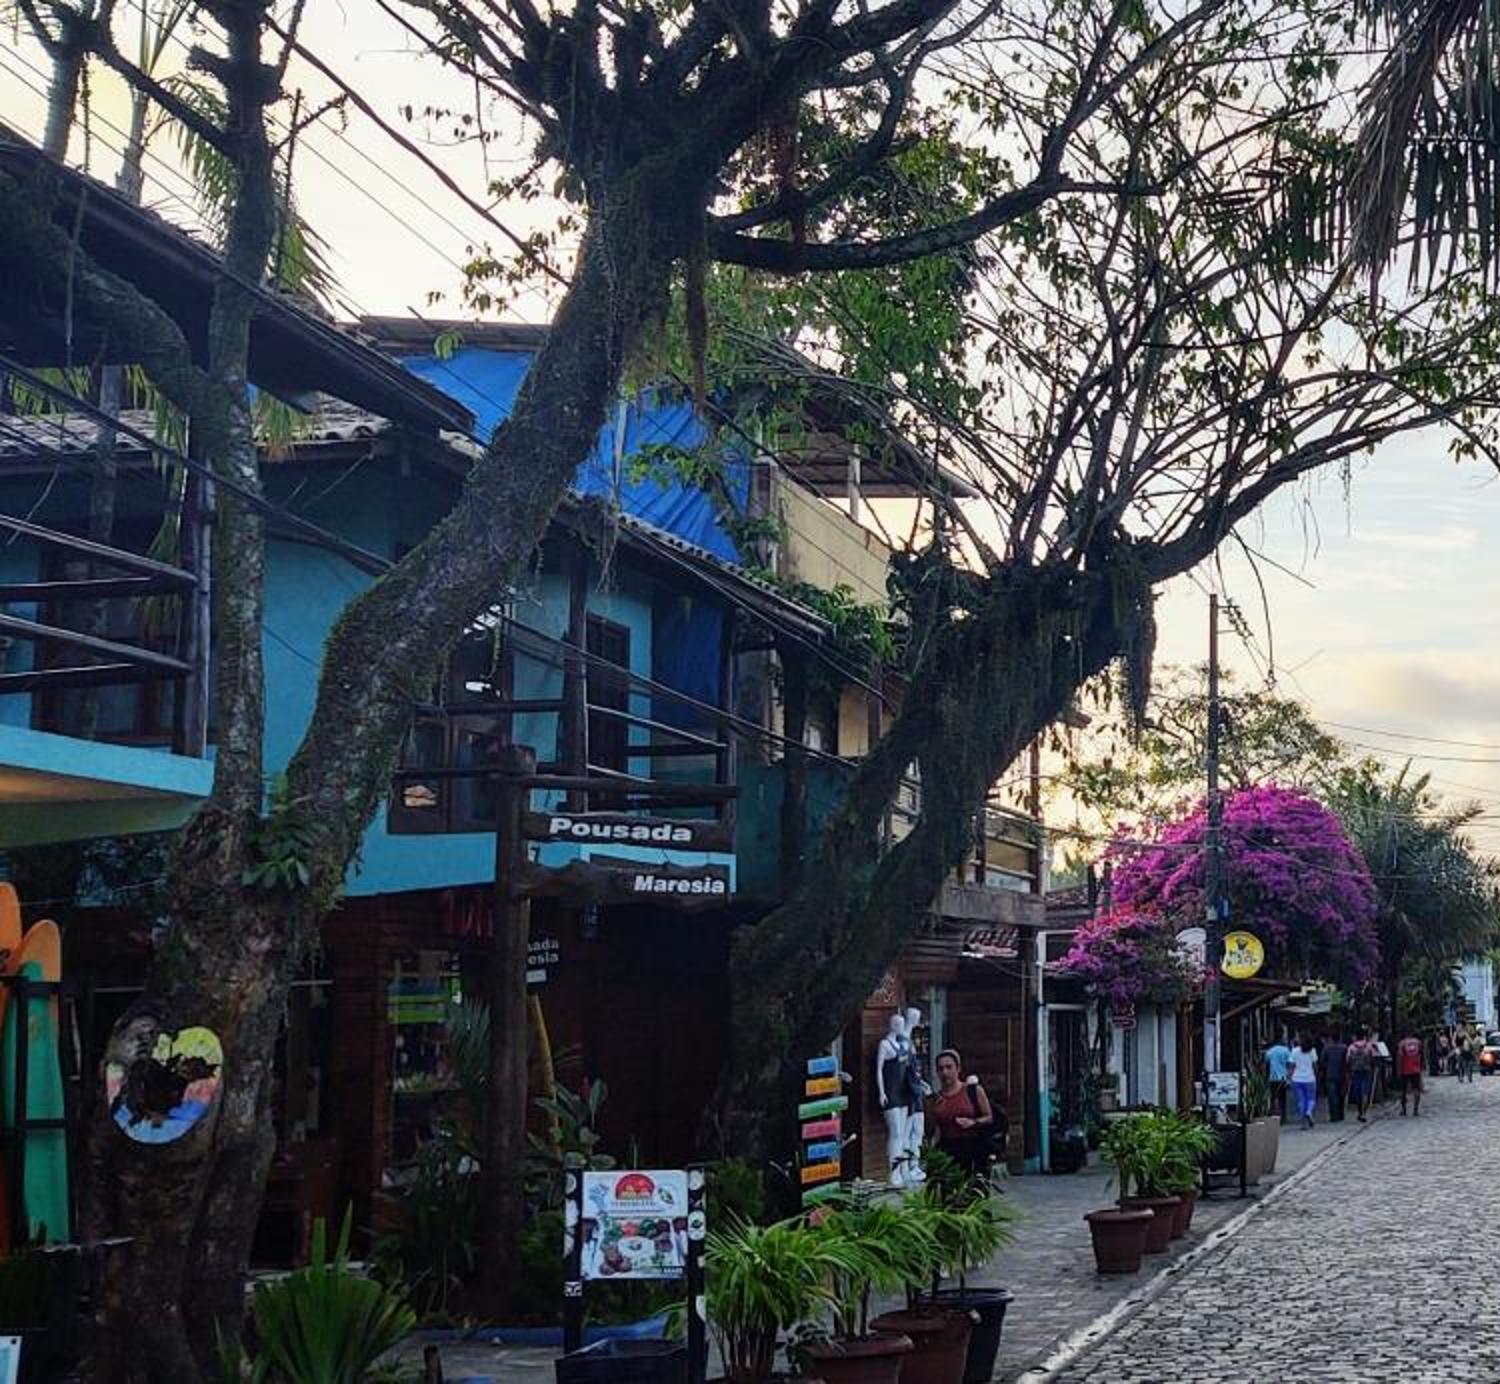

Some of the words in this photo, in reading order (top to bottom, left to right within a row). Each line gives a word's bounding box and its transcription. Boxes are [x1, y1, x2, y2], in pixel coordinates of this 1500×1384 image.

[549, 817, 693, 842] Pousada
[633, 875, 725, 894] Maresia
[527, 951, 559, 965] esia
